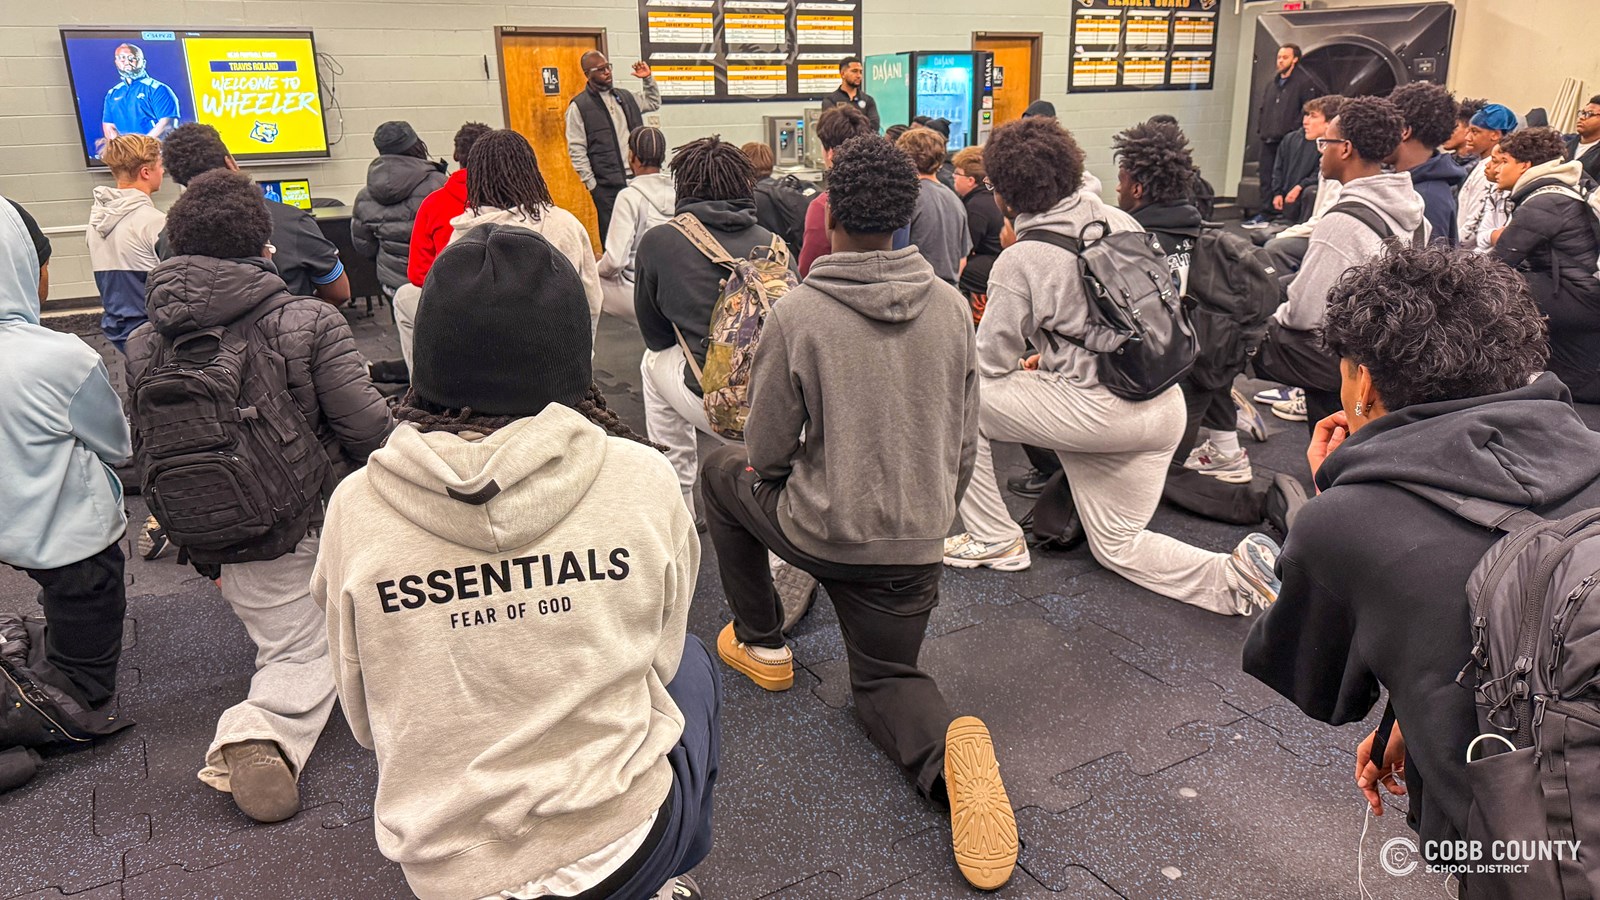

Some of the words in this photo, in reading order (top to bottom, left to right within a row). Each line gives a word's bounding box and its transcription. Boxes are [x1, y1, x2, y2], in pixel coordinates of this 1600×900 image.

[228, 62, 253, 71] TRAVIS
[253, 62, 279, 71] ROLAND
[872, 60, 902, 85] DASANI
[934, 56, 955, 68] DASANI
[985, 57, 993, 87] DASANI
[211, 76, 279, 89] WELCOME
[282, 76, 300, 89] TO
[202, 91, 319, 118] WHEELER
[376, 547, 630, 613] ESSENTIALS
[450, 607, 497, 629] FEAR
[507, 602, 527, 620] OF
[538, 596, 572, 615] GOD
